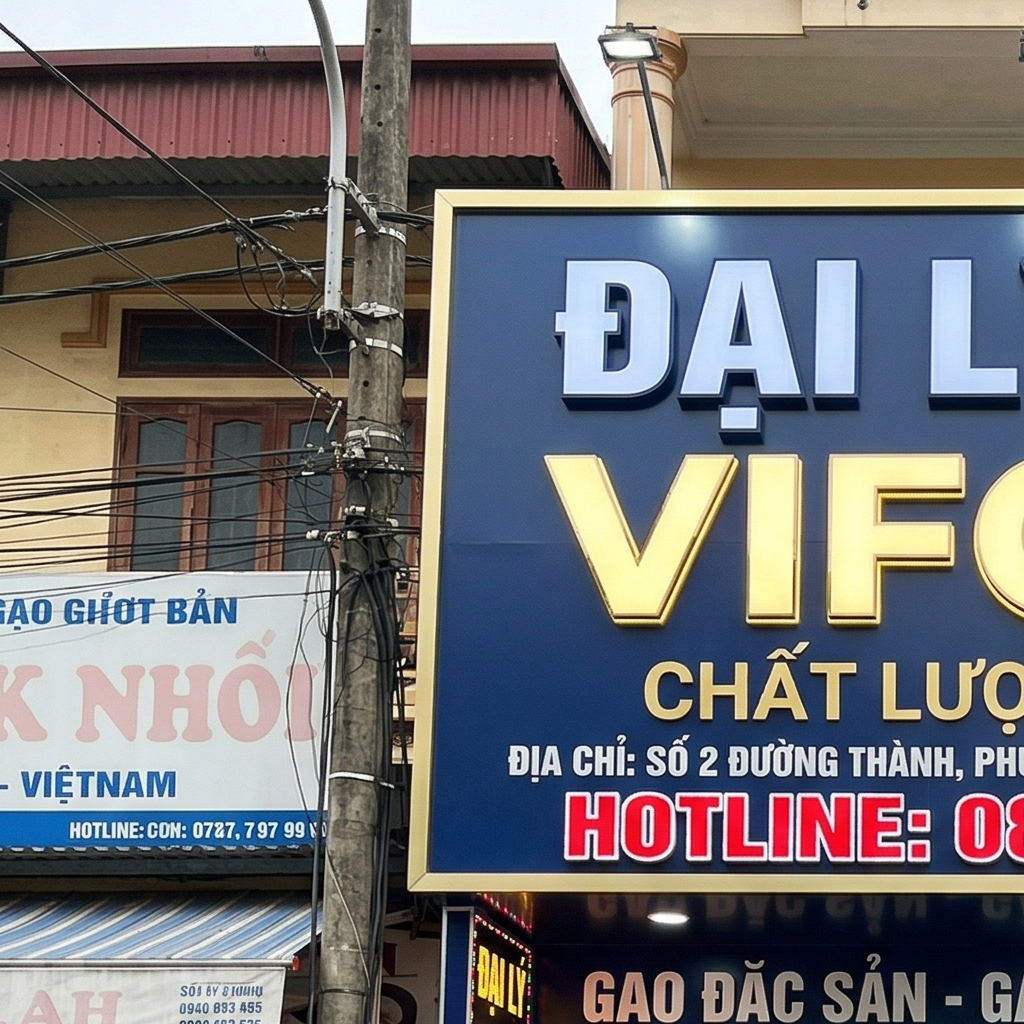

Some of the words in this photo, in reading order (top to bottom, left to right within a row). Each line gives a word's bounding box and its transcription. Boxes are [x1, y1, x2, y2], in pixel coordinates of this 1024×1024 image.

[554, 257, 860, 434] ĐẠI
[0, 597, 51, 631] ẠO
[644, 642, 857, 720] CHẤT
[20, 765, 177, 805] VIỆTNAM
[507, 745, 563, 783] ĐỊA
[572, 735, 635, 777] CHỈ:
[645, 735, 690, 777] SỐ
[698, 746, 718, 777] 2
[727, 738, 838, 778] ĐƯỜNG
[848, 739, 964, 782] THÀNH,
[69, 821, 145, 840] HOTLINE:
[563, 791, 931, 863] HOTLINE:
[822, 953, 926, 1024] SẢN
